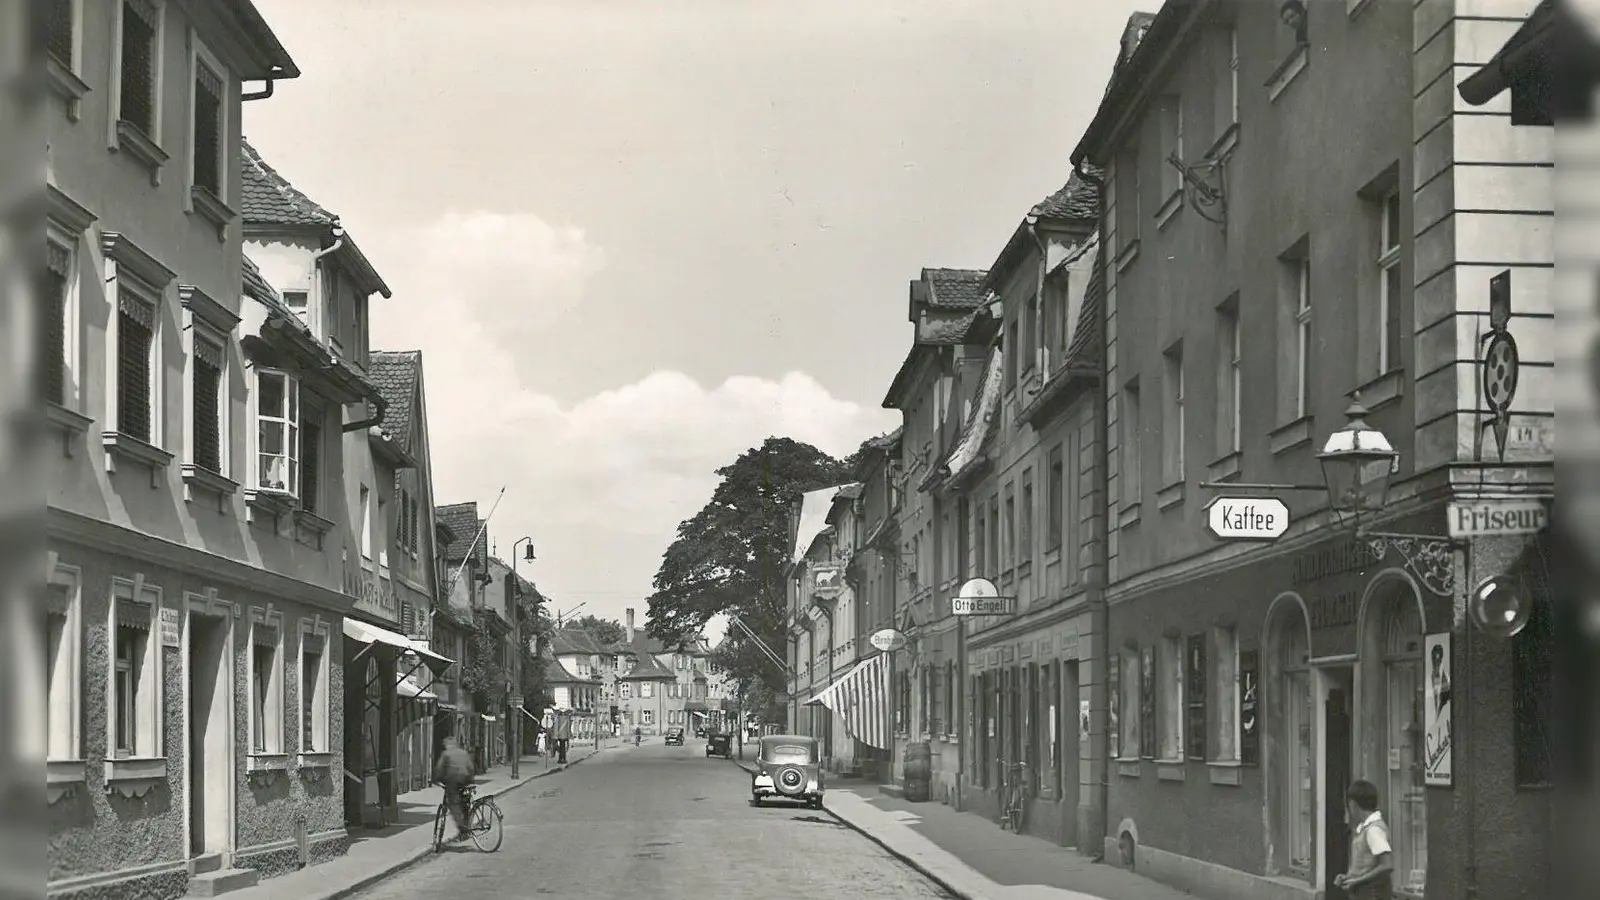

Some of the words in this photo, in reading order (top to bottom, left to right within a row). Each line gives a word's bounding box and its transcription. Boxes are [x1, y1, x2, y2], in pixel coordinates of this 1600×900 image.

[1223, 505, 1274, 530] Kaffee
[1457, 506, 1545, 531] Friseur
[954, 600, 975, 611] Otto
[976, 600, 1003, 611] Engel
